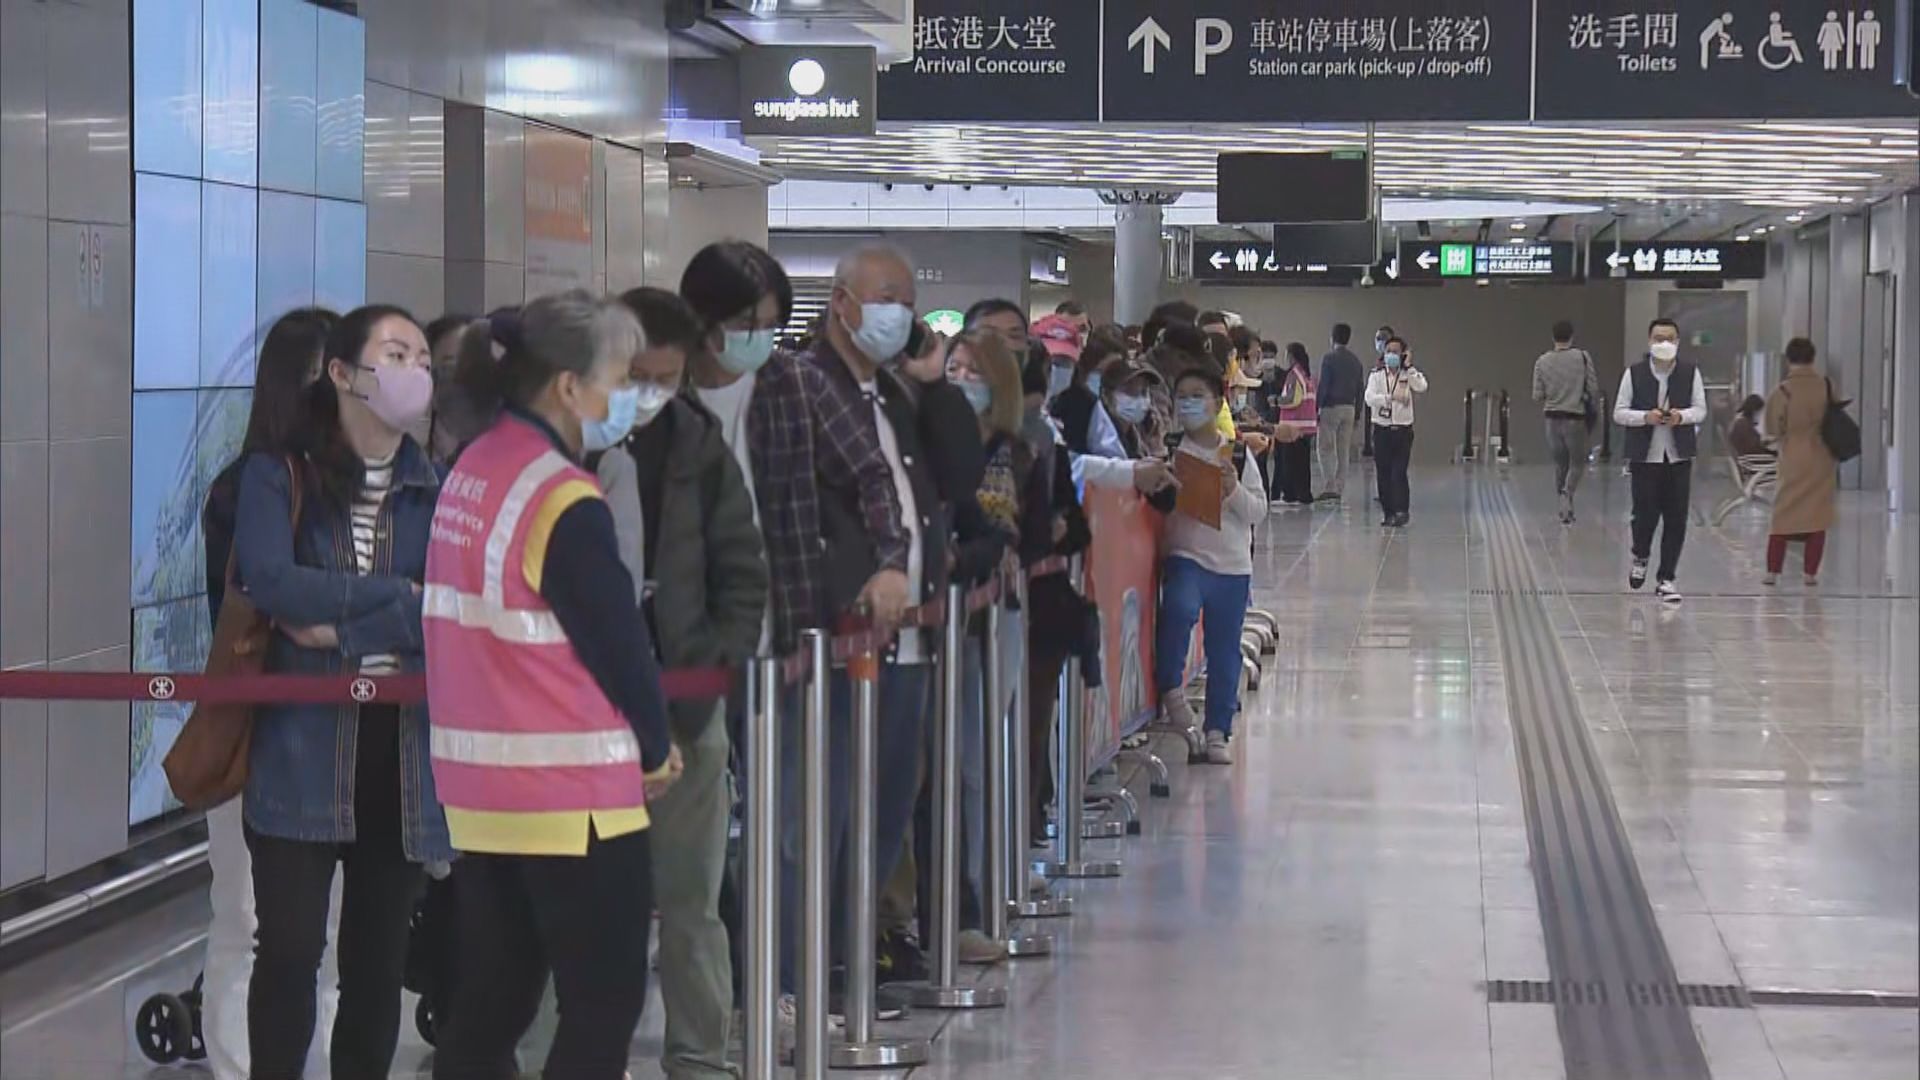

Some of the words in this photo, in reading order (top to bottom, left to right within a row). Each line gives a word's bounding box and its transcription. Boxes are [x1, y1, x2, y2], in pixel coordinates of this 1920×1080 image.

[914, 16, 1056, 50] 抵港大堂
[1250, 16, 1490, 53] 車站停車場(上落客)
[1568, 12, 1678, 49] 洗手間
[1194, 18, 1233, 75] P
[914, 56, 970, 73] Arrival
[975, 57, 1065, 73] Concourse
[1249, 58, 1298, 76] Station
[1301, 62, 1323, 75] car
[1325, 58, 1356, 79] park
[1617, 54, 1677, 72] Toilets
[753, 98, 828, 121] sunglass
[829, 98, 860, 118] hut
